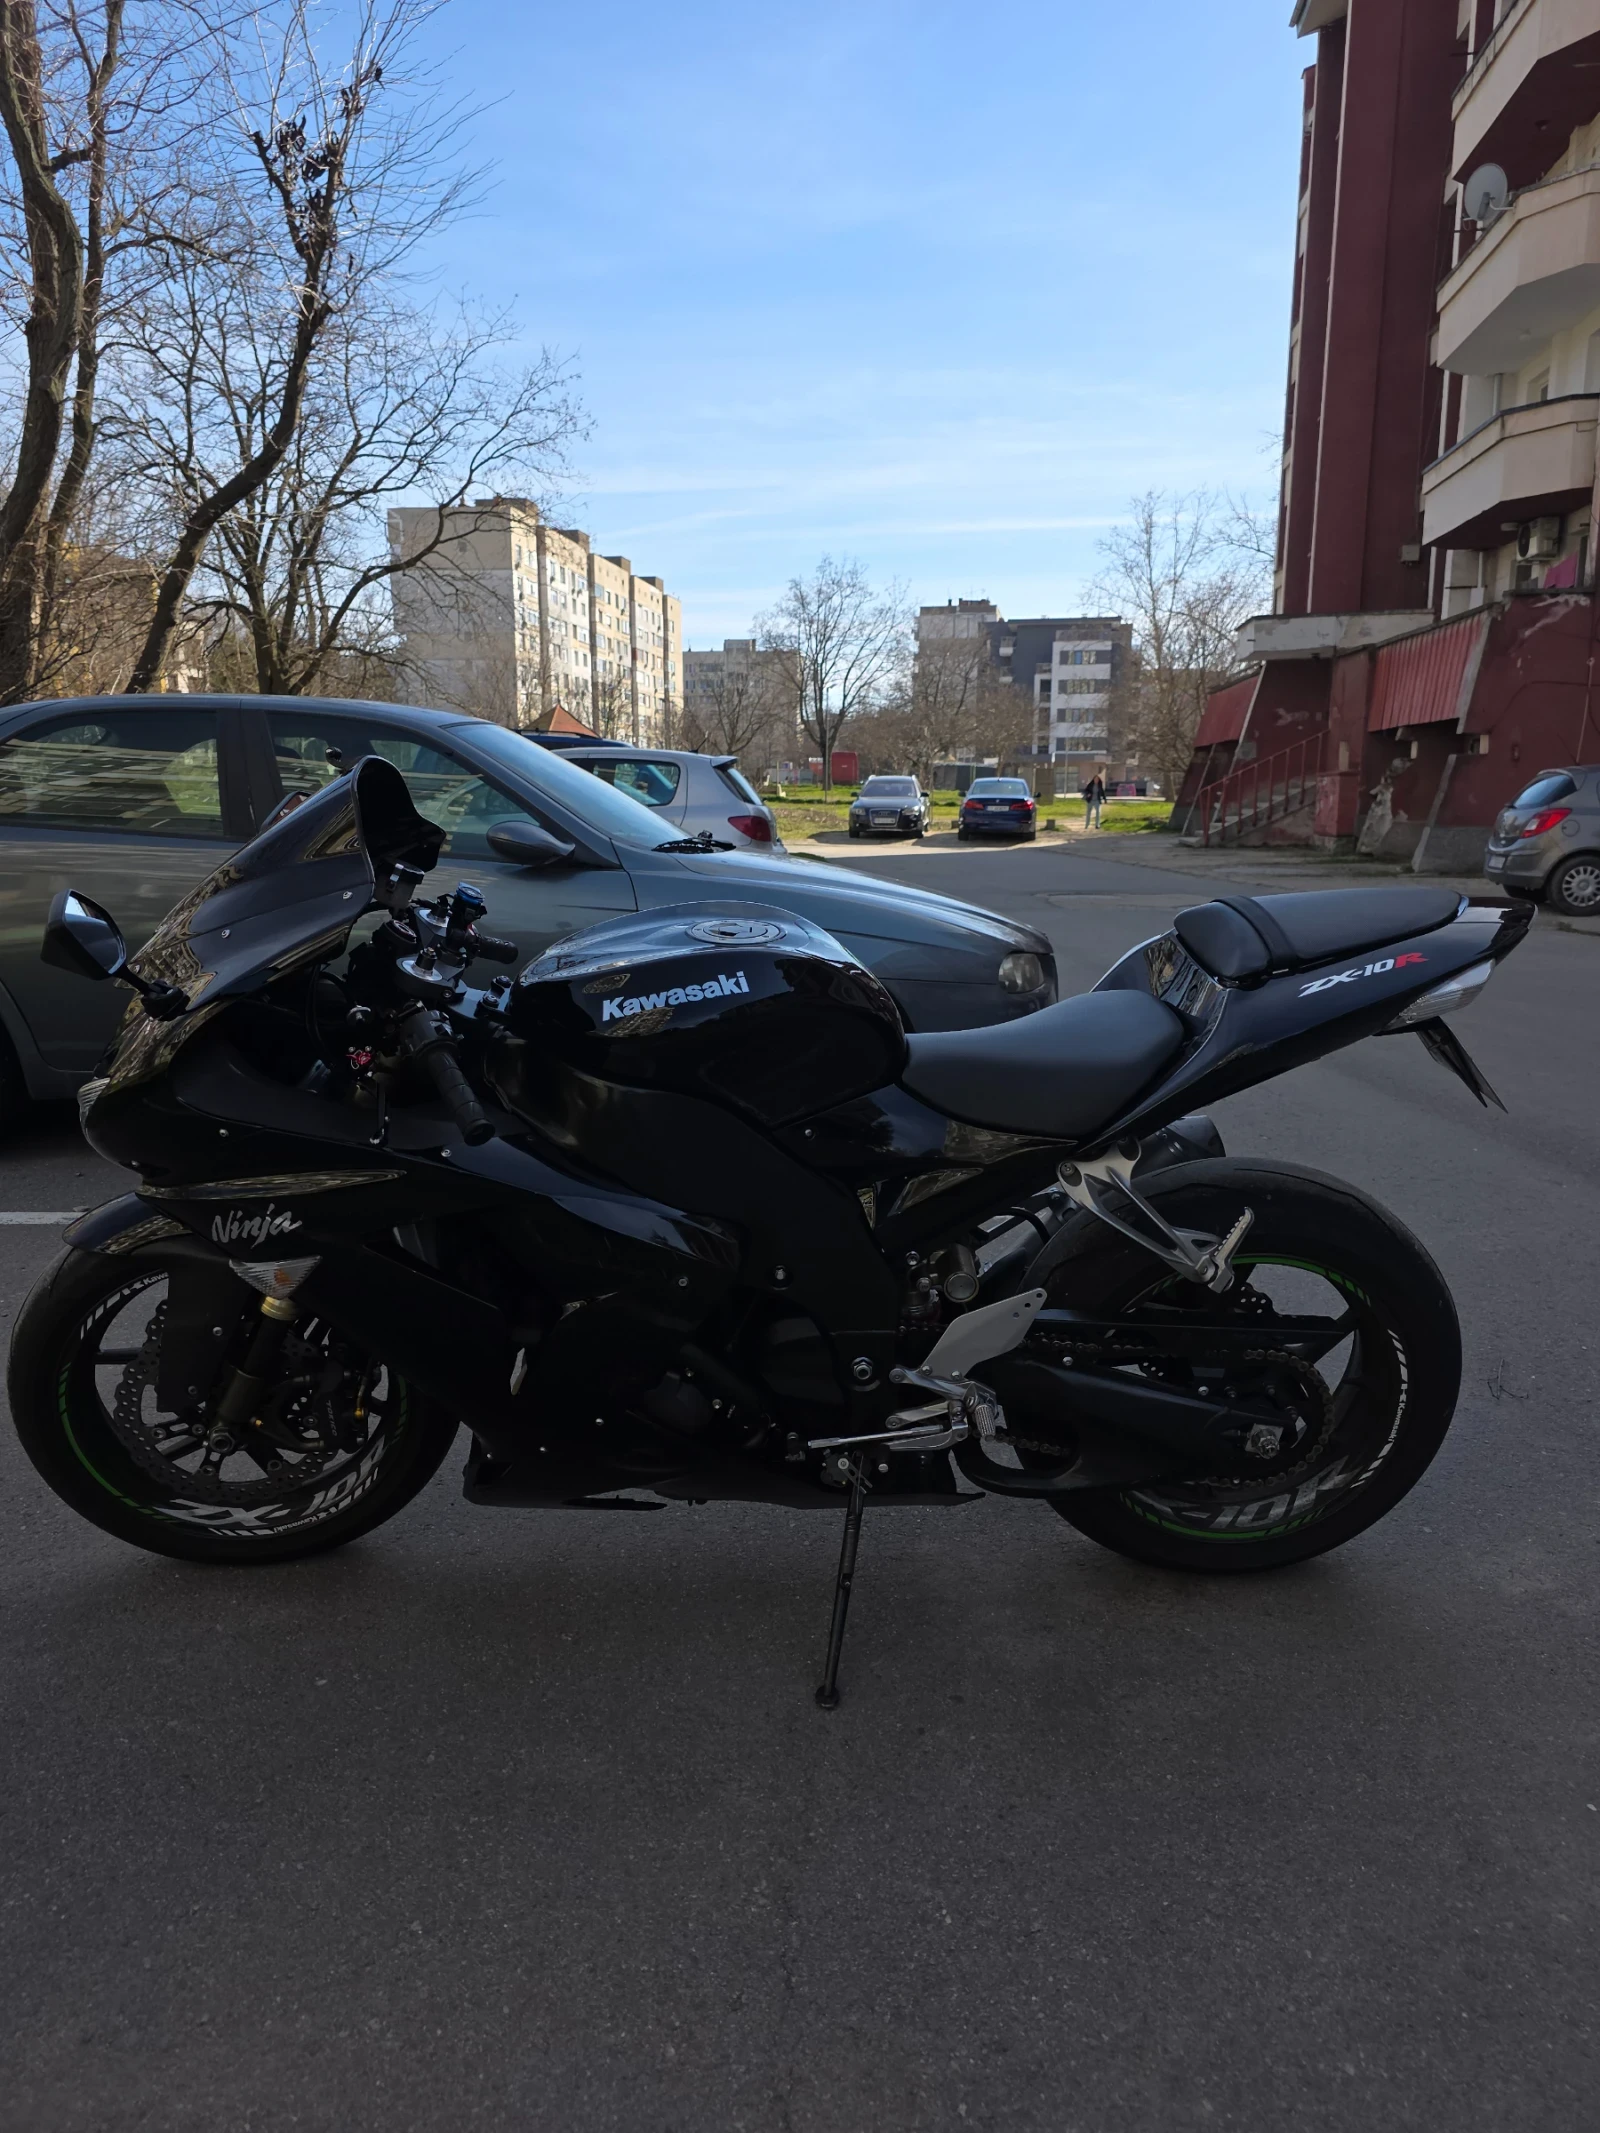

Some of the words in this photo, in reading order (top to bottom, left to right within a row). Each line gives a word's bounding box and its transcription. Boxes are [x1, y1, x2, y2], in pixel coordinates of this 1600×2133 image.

[602, 970, 750, 1022] Kawasaki
[1297, 952, 1430, 998] ZX-10R
[211, 1202, 303, 1250] Ninja
[325, 1400, 338, 1436] TOKICO
[1387, 1402, 1406, 1442] Kawasaki
[273, 1515, 318, 1533] Kawasaki
